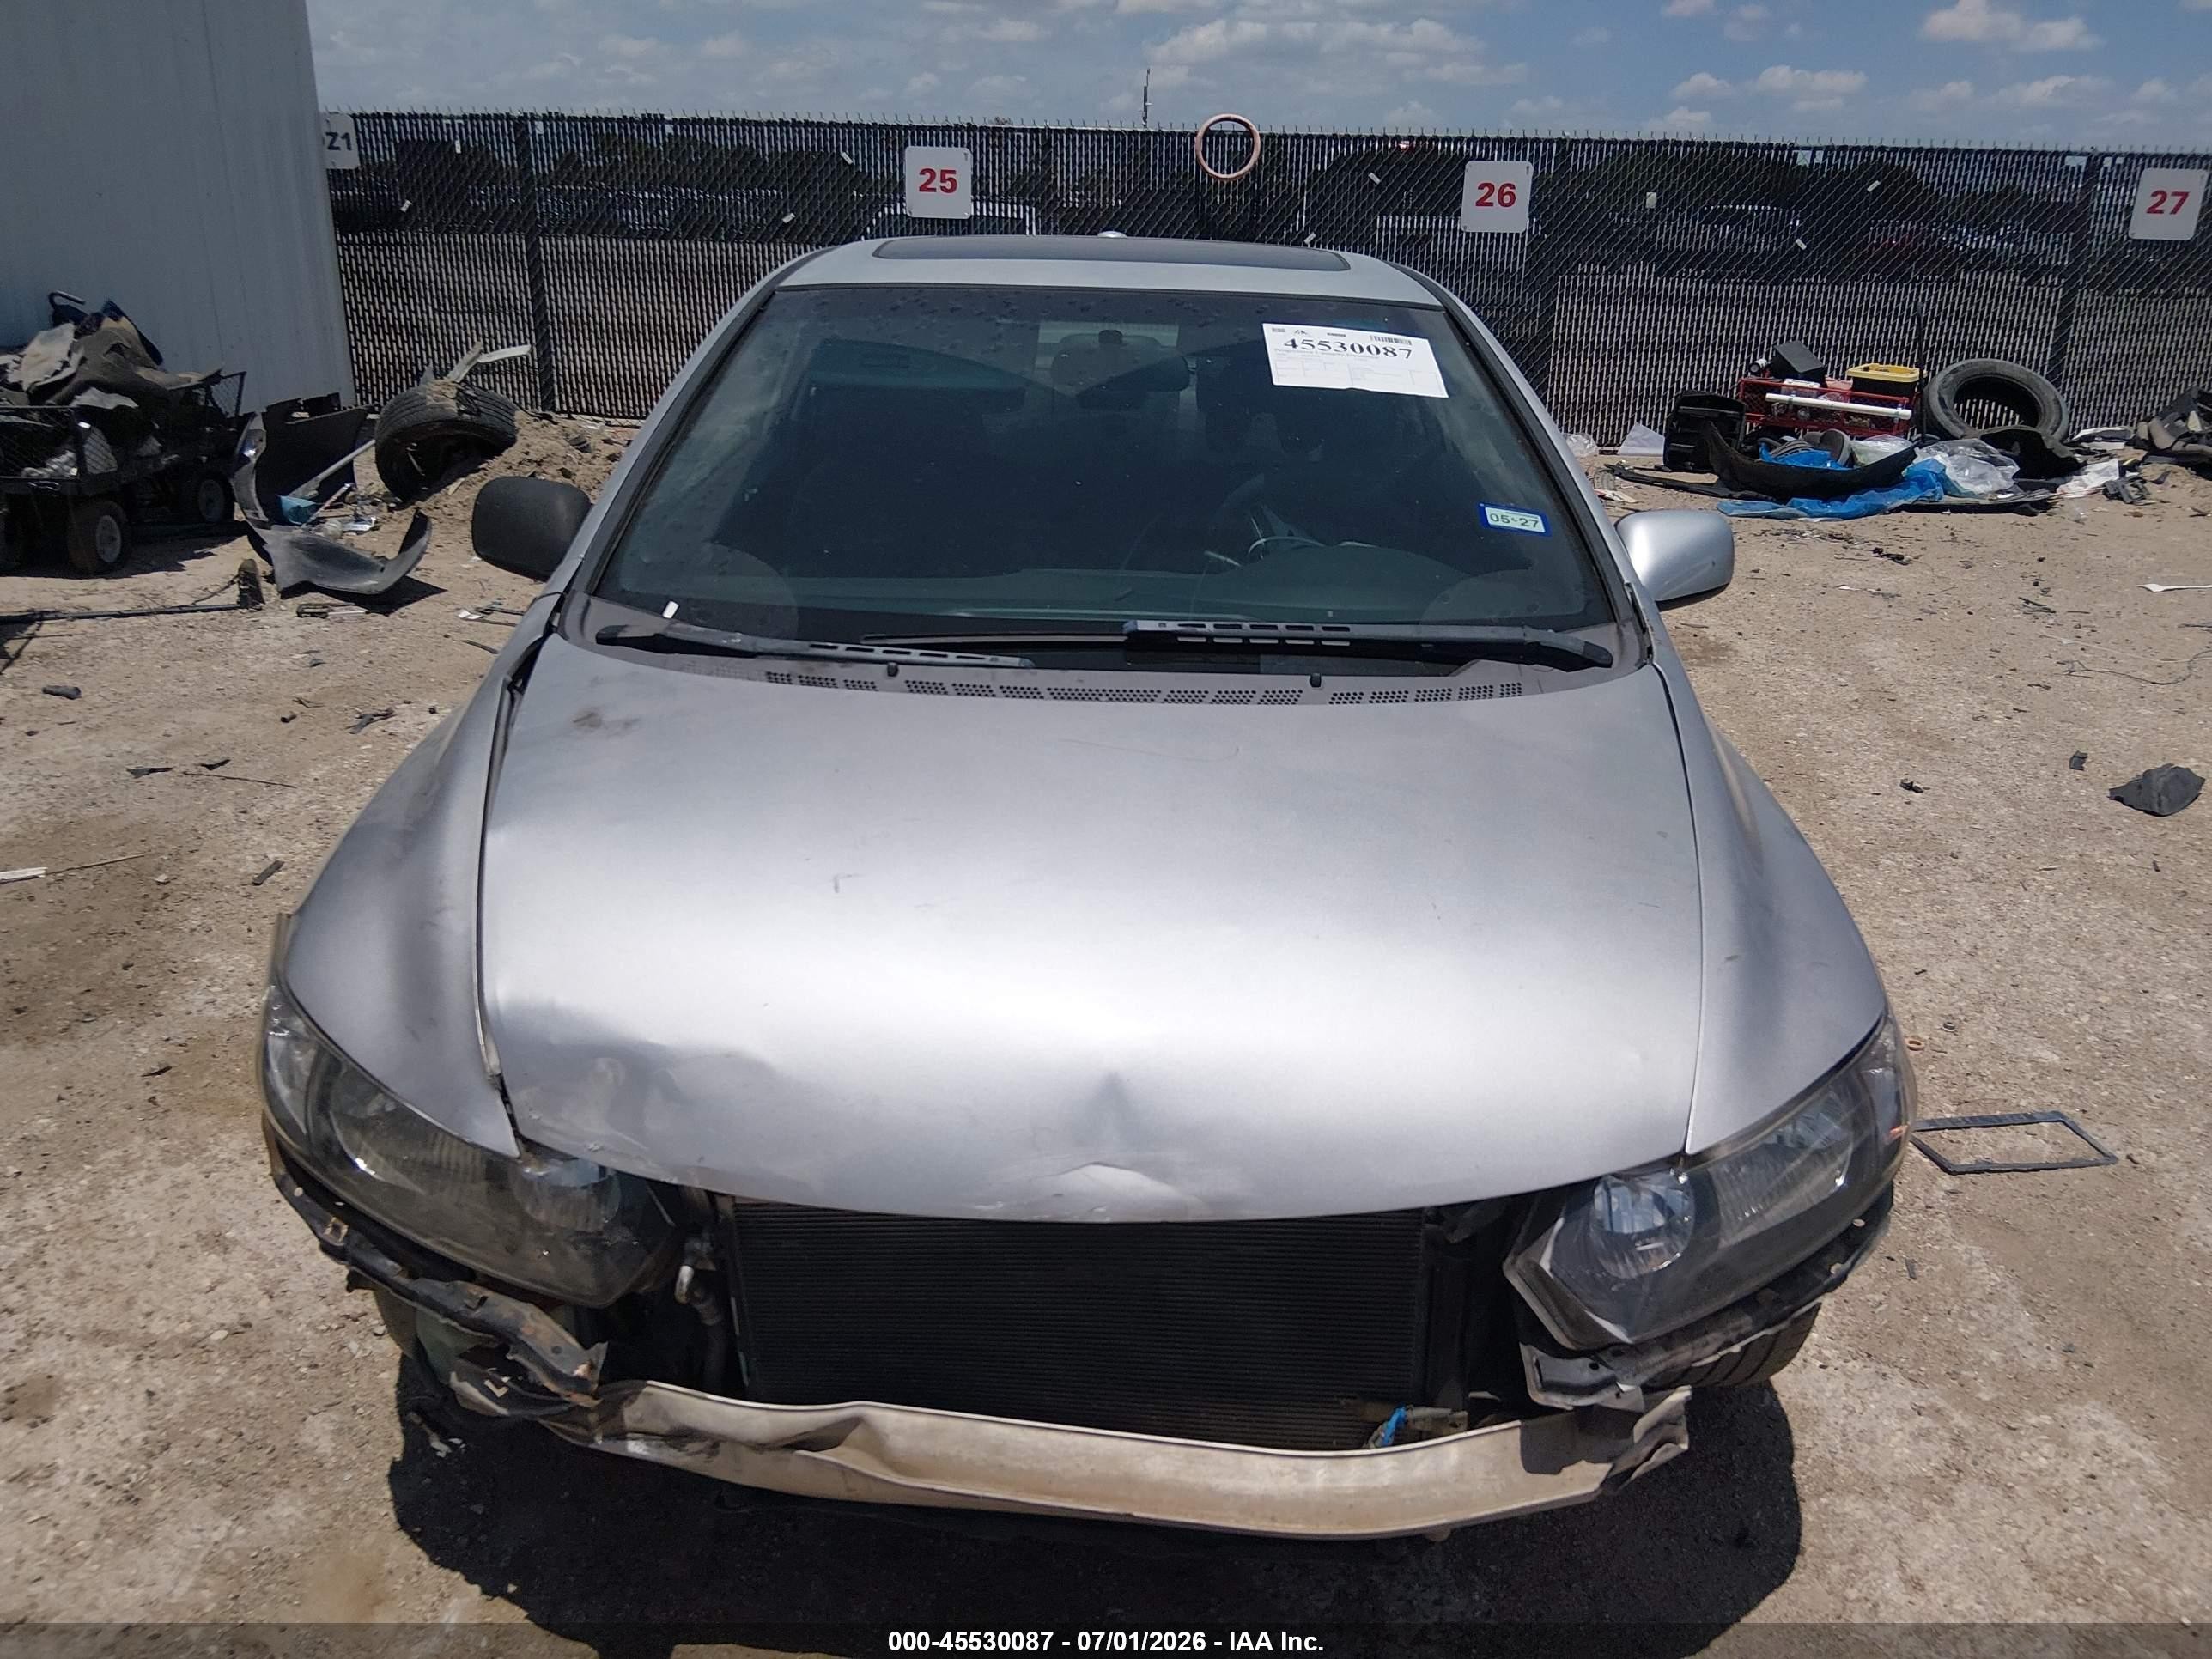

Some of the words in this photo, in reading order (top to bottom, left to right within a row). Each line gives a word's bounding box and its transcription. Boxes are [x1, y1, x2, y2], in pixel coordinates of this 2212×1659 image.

[322, 131, 352, 151] Z1
[918, 167, 958, 194] 25
[1475, 182, 1516, 208] 26
[2146, 189, 2191, 215] 27
[1283, 337, 1413, 360] 45530087
